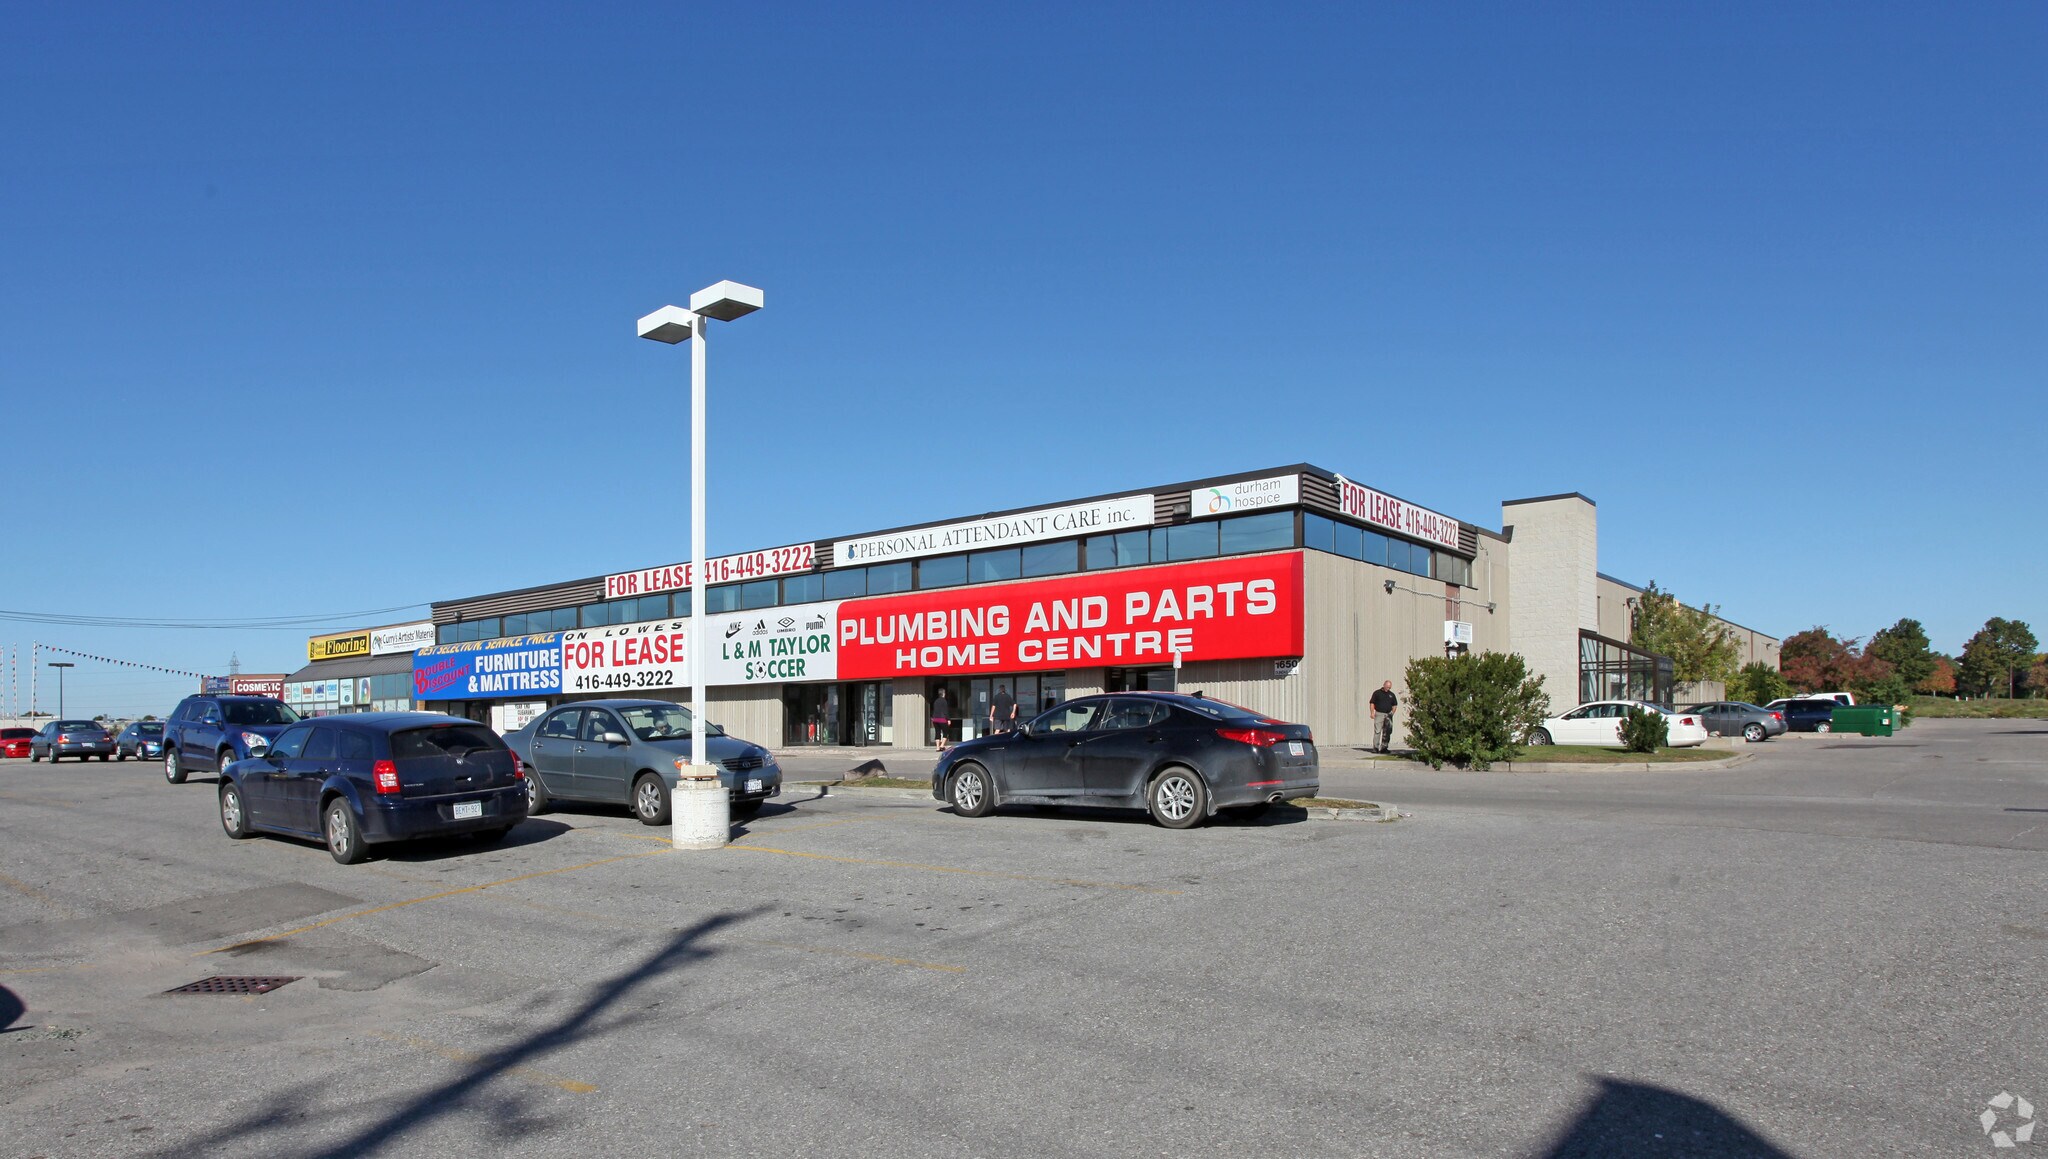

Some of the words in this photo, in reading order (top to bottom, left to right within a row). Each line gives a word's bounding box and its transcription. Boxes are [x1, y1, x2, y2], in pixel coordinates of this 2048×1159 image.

[1235, 480, 1280, 494] durham
[1235, 493, 1280, 507] hospice
[1343, 483, 1366, 518] FOR
[1369, 492, 1401, 530] LEASE
[1405, 507, 1457, 547] 416-449-3222
[860, 533, 937, 558] PERSONAL
[942, 517, 1048, 547] ATTENDANT
[1053, 508, 1101, 531] CARE
[1108, 507, 1135, 523] inc.
[608, 574, 638, 597] FOR
[644, 564, 692, 592] LEASE
[705, 545, 812, 583] 416-449-3222
[840, 604, 1010, 647] PLUMBING
[1024, 595, 1108, 633] AND
[1125, 578, 1277, 625] PARTS
[565, 632, 588, 640] ON
[605, 622, 683, 638] LOWES
[729, 621, 742, 631] NIKE
[806, 620, 823, 630] PUMA
[326, 638, 366, 655] Flooring
[564, 641, 604, 670] FOR
[612, 633, 684, 667] LEASE
[722, 642, 730, 660] L
[734, 642, 744, 660] &
[748, 640, 762, 658] M
[769, 634, 831, 656] TAYLOR
[896, 642, 1000, 669] HOME
[1018, 627, 1194, 663] CENTRE
[414, 656, 455, 685] DOUBLE
[476, 648, 560, 674] FURNITURE
[1275, 659, 1298, 669] 1650
[237, 683, 281, 692] COSMETIC
[468, 676, 478, 692] &
[481, 670, 560, 692] MATTRESS
[576, 670, 673, 690] 416-449-3222
[868, 684, 876, 741] ENTRANCE
